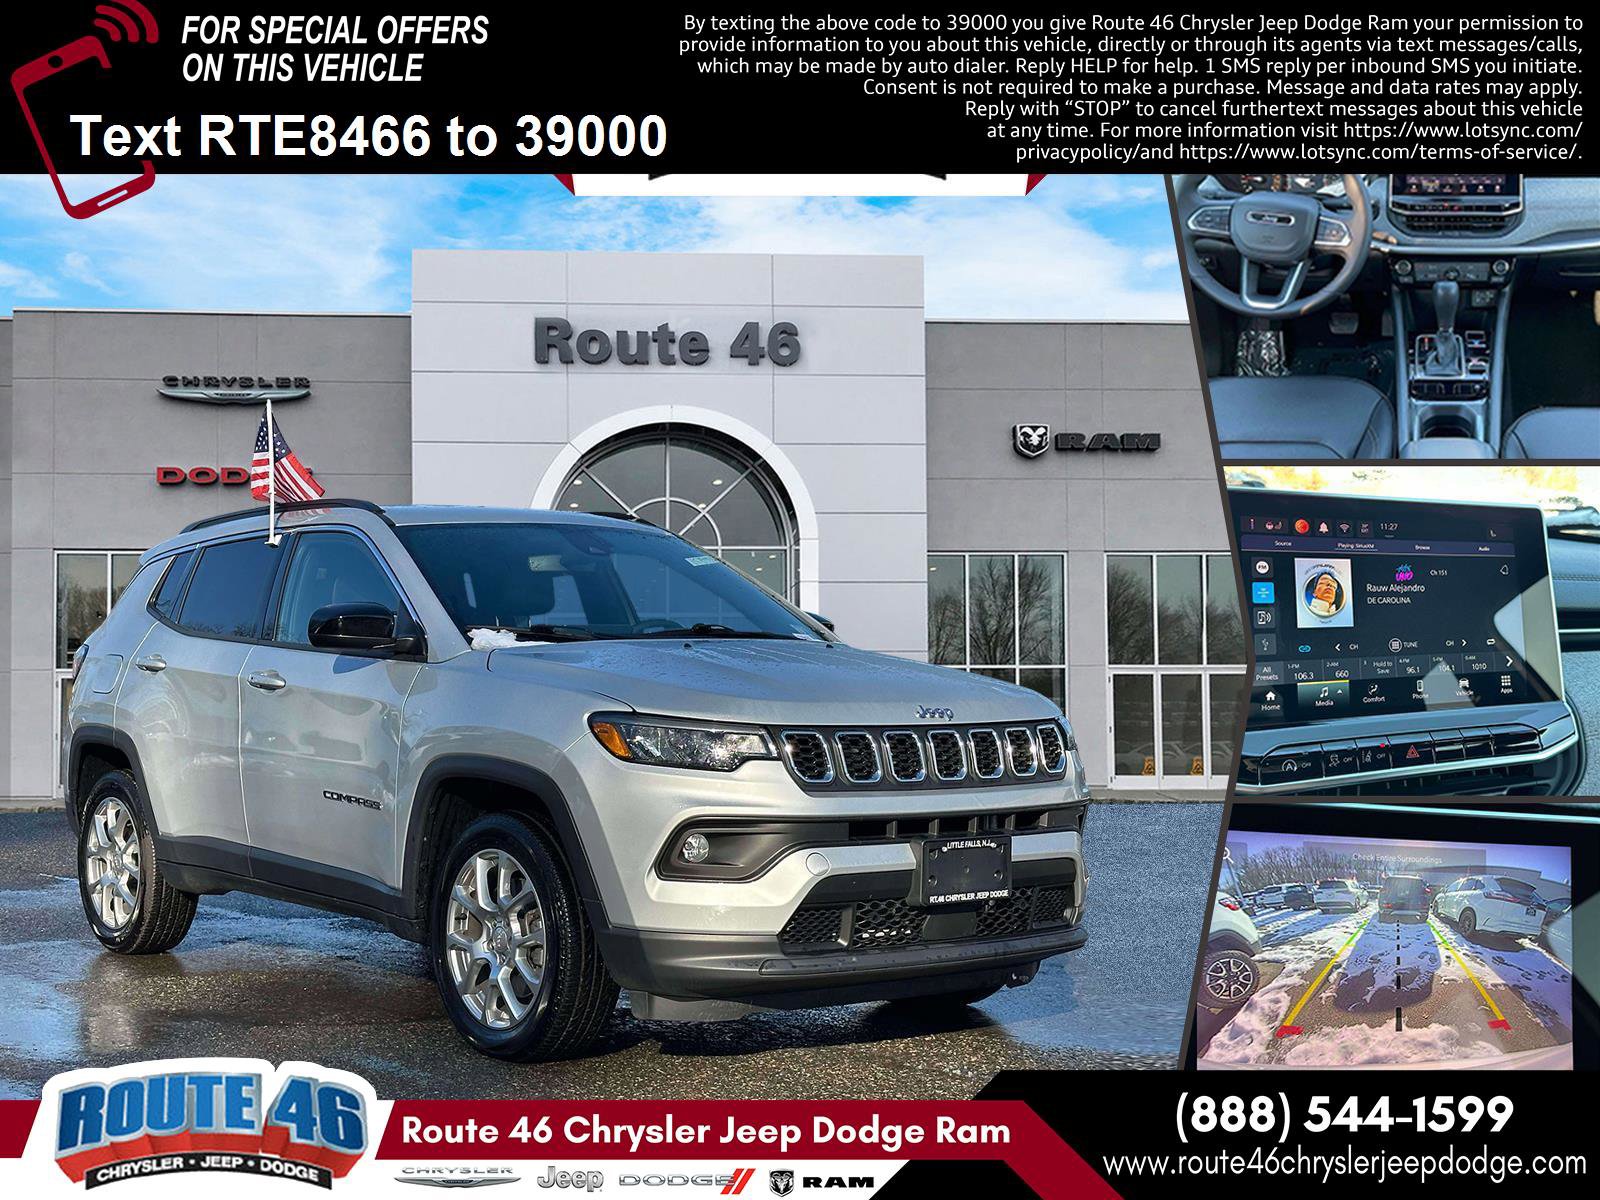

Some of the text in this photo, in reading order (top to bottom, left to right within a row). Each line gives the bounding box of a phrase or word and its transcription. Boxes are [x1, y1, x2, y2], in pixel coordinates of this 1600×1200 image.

[534, 317, 801, 367] Route 46
[162, 375, 312, 388] CHRYSLER
[1054, 432, 1161, 452] RAM
[1379, 522, 1399, 531] 11:27
[1366, 583, 1426, 593] Rauw Alejandro
[1367, 596, 1411, 605] DE CAROLINA
[1255, 673, 1279, 682] Presets
[1294, 672, 1315, 680] 106.3
[1335, 670, 1350, 679] 660
[1315, 699, 1334, 707] Media
[1362, 695, 1386, 704] Comfort
[1261, 703, 1281, 711] Home
[915, 704, 954, 722] Jeep
[322, 790, 383, 811] COMPASS
[946, 841, 965, 850] LITTLE
[945, 892, 976, 902] CHRYSLER
[975, 891, 990, 900] JEEP
[989, 889, 1009, 899] DODGE
